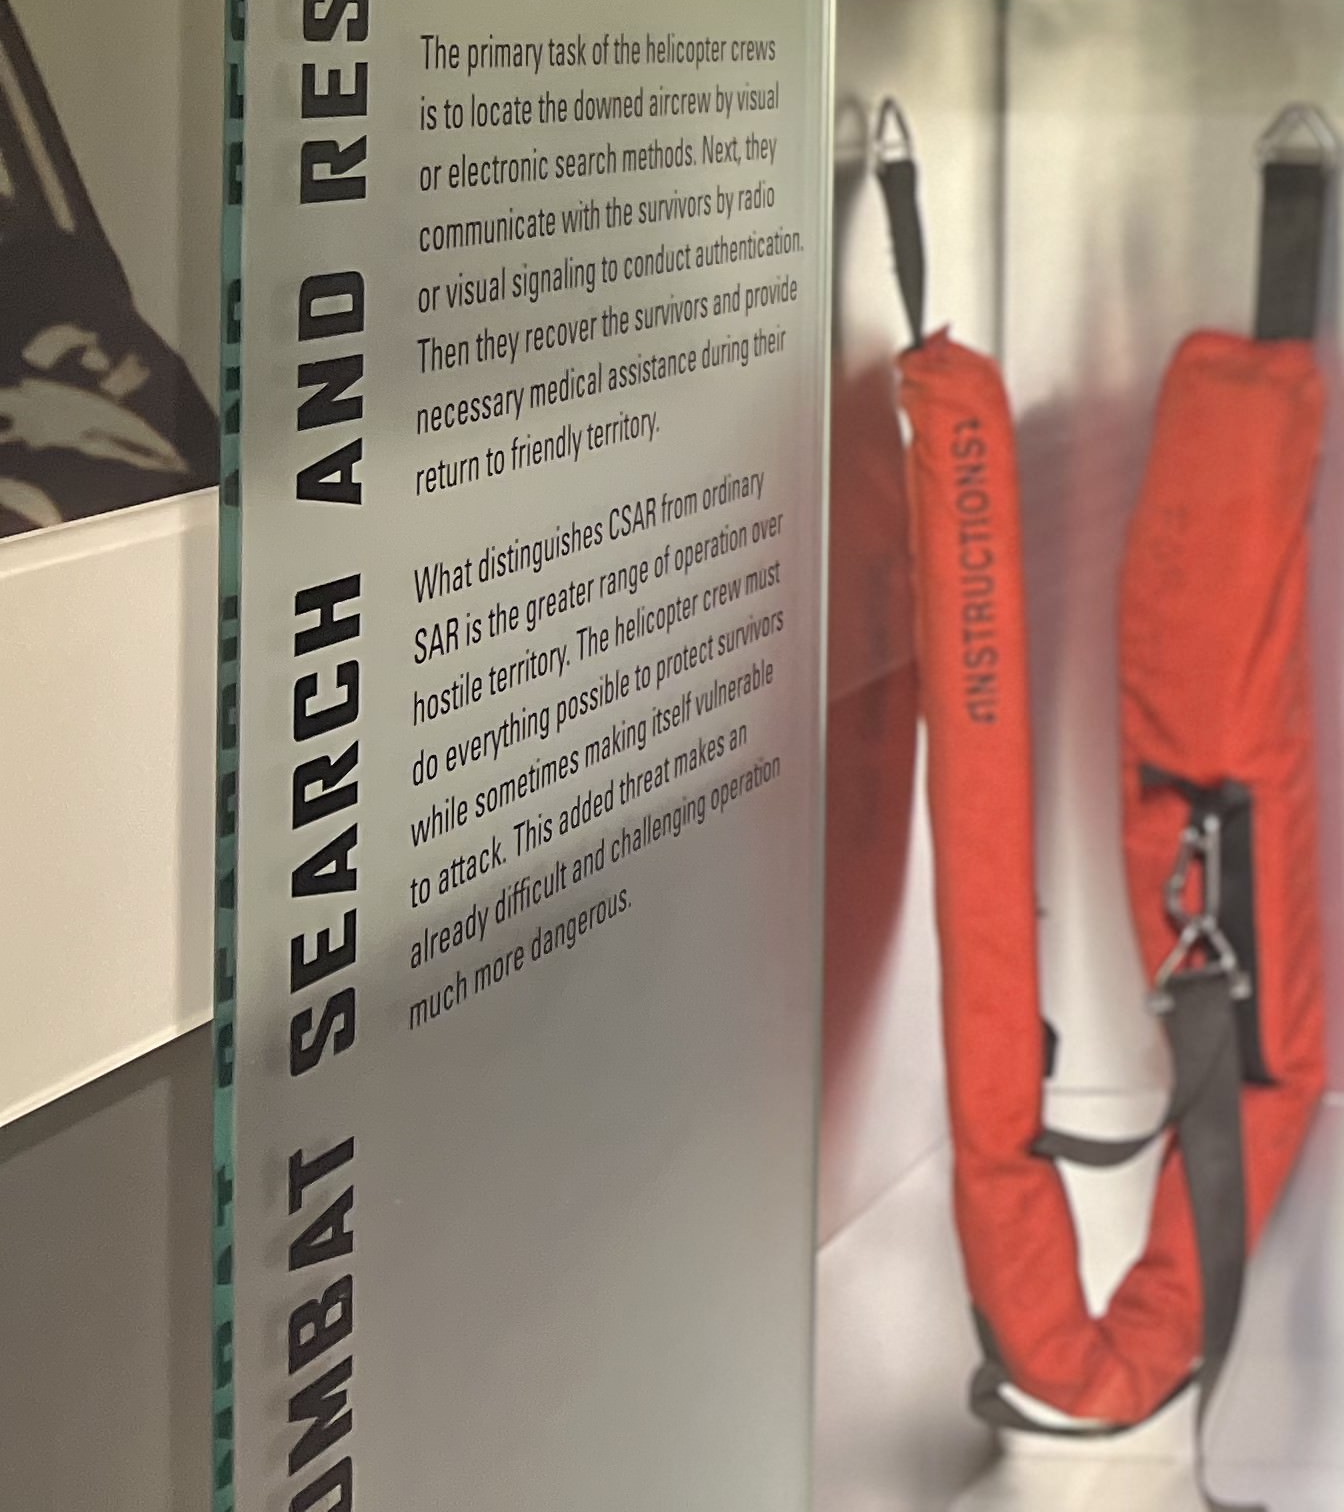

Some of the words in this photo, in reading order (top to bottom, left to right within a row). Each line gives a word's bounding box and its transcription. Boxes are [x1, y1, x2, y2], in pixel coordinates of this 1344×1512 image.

[420, 34, 460, 70] The
[467, 33, 544, 77] primary
[547, 33, 587, 67] task
[591, 32, 610, 66] of
[613, 32, 641, 65] the
[646, 33, 728, 70] helicopter
[730, 39, 776, 62] crews
[420, 95, 438, 131] is
[443, 99, 464, 130] to
[470, 93, 533, 128] locate
[537, 90, 568, 124] the
[573, 86, 644, 122] downed
[648, 85, 712, 117] aircrew
[715, 84, 734, 119] by
[736, 81, 780, 112] visual
[419, 164, 443, 192] or
[448, 147, 549, 189] electronic
[555, 142, 617, 179] search
[622, 137, 697, 173] methods.
[702, 135, 742, 165] Next,
[744, 132, 777, 165] they
[419, 207, 556, 253] communicate
[561, 198, 601, 234] with
[605, 196, 633, 229] the
[638, 189, 712, 225] survivors
[716, 184, 735, 220] by
[737, 180, 775, 212] radio
[417, 285, 441, 314] or
[445, 266, 506, 309] visual
[511, 256, 596, 304] signaling
[601, 256, 618, 284] to
[623, 243, 692, 281] conduct
[695, 226, 804, 269] authentication.
[417, 337, 470, 374] Then
[475, 327, 520, 365] they
[525, 316, 598, 353] recover
[600, 305, 630, 338] the
[634, 294, 709, 332] survivors
[712, 282, 741, 317] and
[745, 274, 798, 317] provide
[295, 269, 367, 507] AND
[416, 387, 525, 435] necessary
[529, 362, 602, 409] medical
[607, 349, 697, 391] assistance
[701, 334, 749, 370] during
[752, 329, 787, 358] their
[416, 455, 480, 497] return
[485, 447, 505, 478] to
[510, 423, 582, 471] friendly
[586, 411, 660, 451] territory.
[413, 616, 459, 665] SAR
[466, 612, 482, 647] is
[487, 602, 520, 638] the
[525, 578, 595, 633] greater
[599, 560, 649, 598] range
[654, 544, 670, 579] of
[674, 524, 747, 575] operation
[751, 513, 784, 544] over
[414, 558, 473, 604] What
[478, 521, 604, 583] distinguishes
[608, 496, 657, 541] CSAR
[661, 492, 698, 523] from
[702, 471, 765, 511] ordinary
[951, 438, 998, 708] INSTRUCTIONS
[412, 748, 439, 787] do
[445, 706, 550, 772] everything
[556, 669, 630, 734] possible
[634, 664, 651, 692] to
[656, 635, 714, 691] protect
[717, 610, 784, 657] survivors
[413, 671, 483, 727] hostile
[488, 644, 571, 696] territory.
[579, 625, 609, 661] The
[615, 593, 699, 647] helicopter
[702, 578, 742, 612] crew
[745, 561, 781, 596] must
[289, 571, 362, 1078] SEARCH
[409, 877, 431, 909] to
[438, 835, 507, 895] attack.
[513, 813, 553, 857] This
[558, 778, 614, 836] added
[618, 757, 670, 806] threat
[674, 734, 725, 779] makes
[729, 724, 748, 752] an
[410, 795, 469, 848] while
[474, 749, 580, 819] sometimes
[585, 719, 647, 768] making
[652, 690, 692, 737] itself
[695, 658, 774, 717] vulnerable
[410, 903, 489, 970] already
[494, 860, 568, 925] difficult
[572, 837, 605, 884] and
[610, 794, 706, 864] challenging
[710, 756, 781, 814] operation
[409, 970, 468, 1031] much
[474, 945, 525, 994] more
[530, 888, 632, 962] dangerous.
